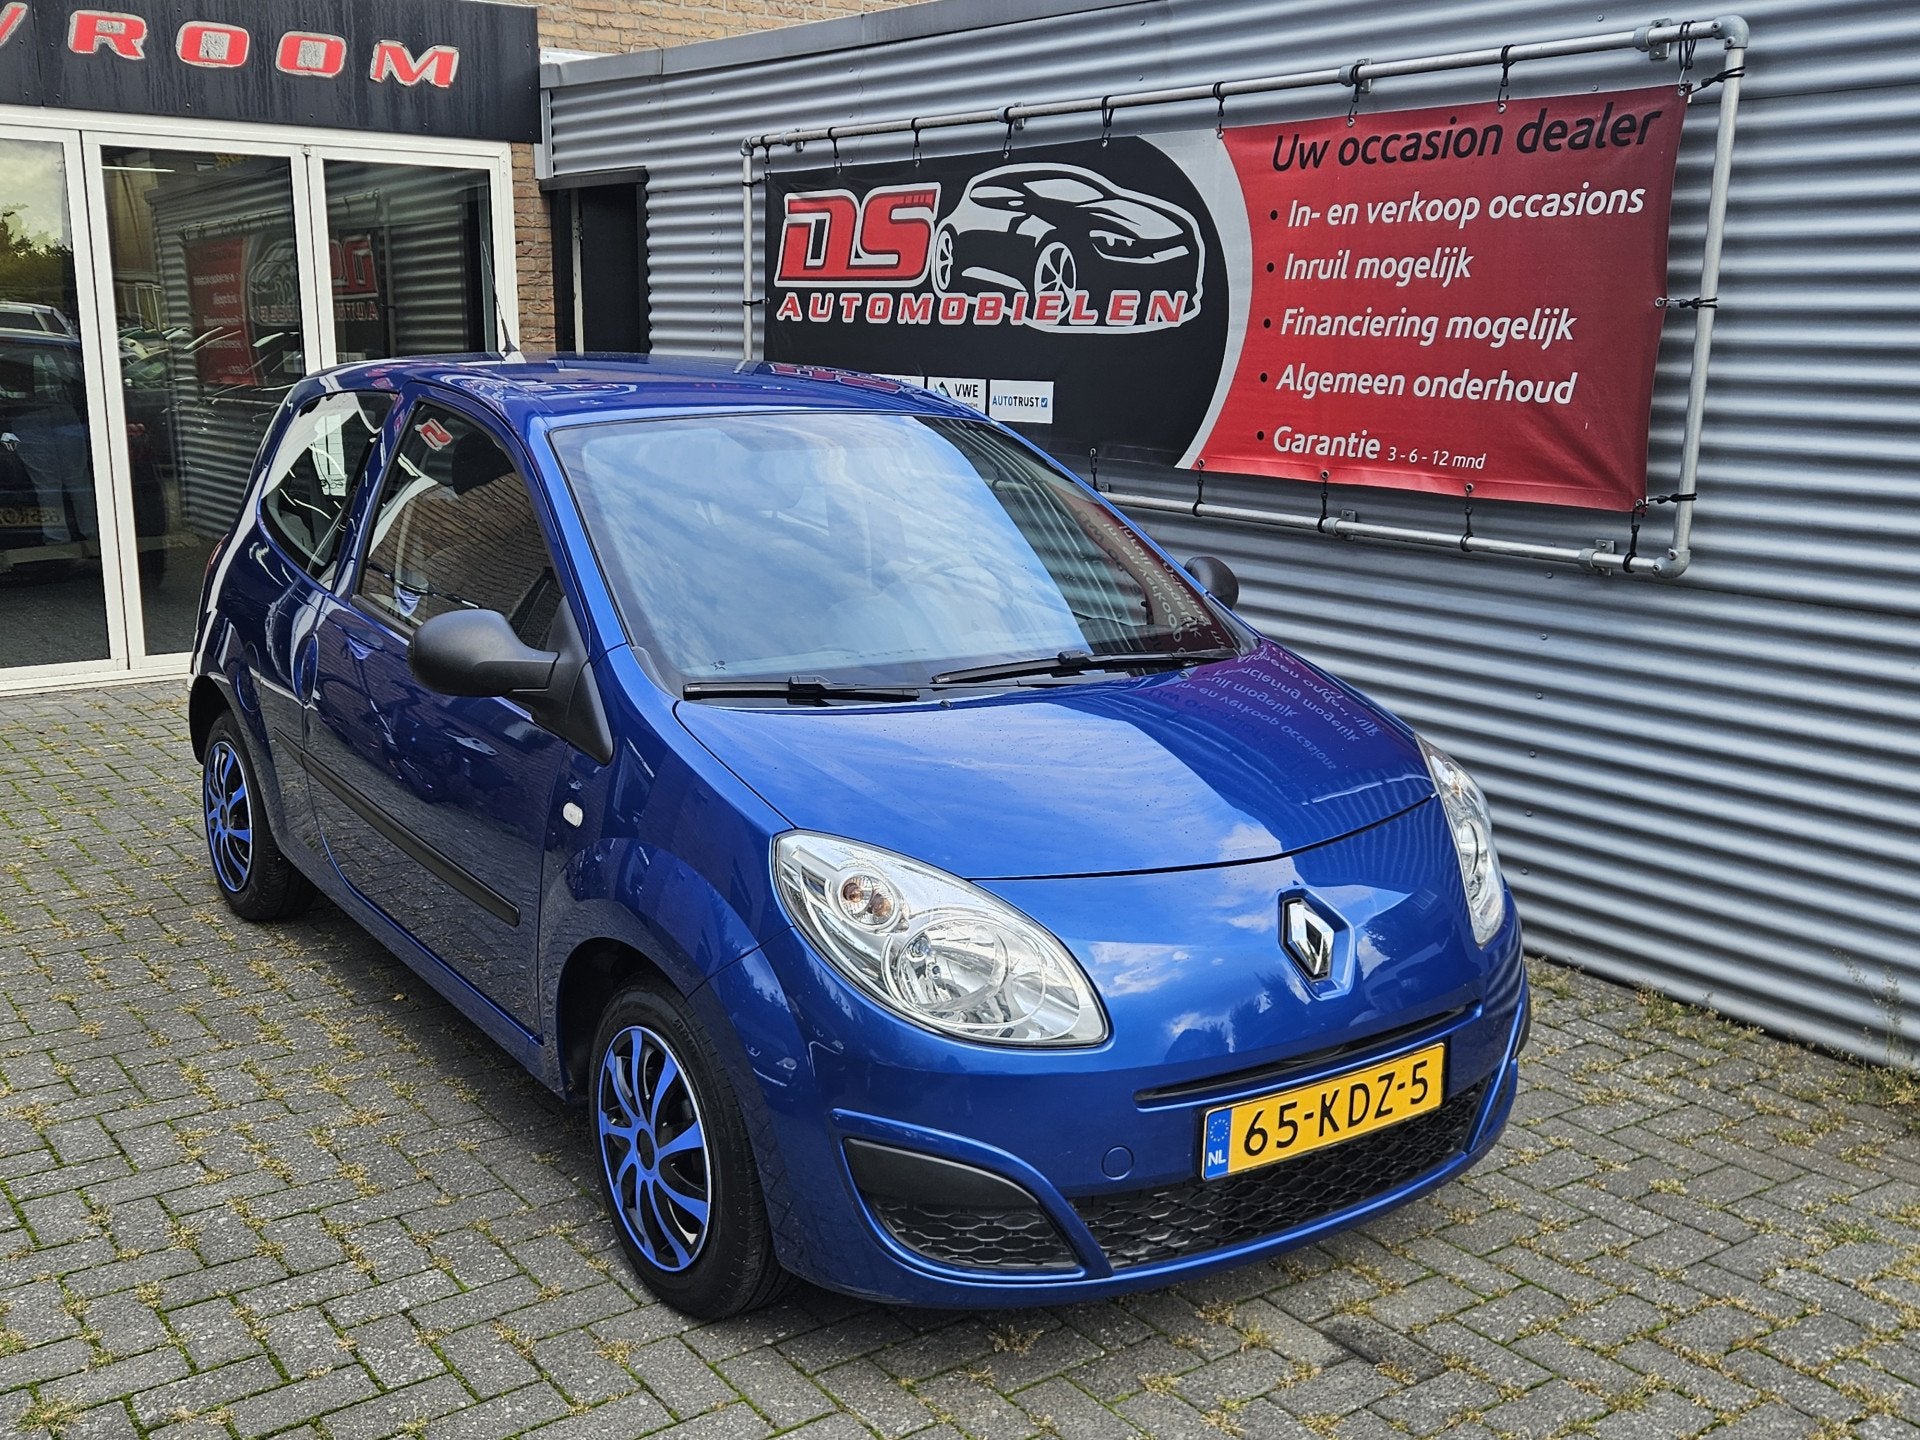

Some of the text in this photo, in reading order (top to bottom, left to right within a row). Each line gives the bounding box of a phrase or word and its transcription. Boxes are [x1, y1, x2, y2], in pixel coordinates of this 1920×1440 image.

[1272, 102, 1662, 172] Uw occasion dealer
[1287, 182, 1646, 229] In- en verkoop occasions
[775, 183, 941, 287] DS
[1284, 247, 1474, 288] Inruil mogelijk
[777, 290, 1187, 325] AUTOMOBIELEN
[1280, 307, 1577, 350] Financiering mogelijk
[954, 383, 979, 398] VWE
[992, 396, 1039, 408] AUTOTRUST
[1276, 364, 1578, 404] Algemeen onderhoud
[1273, 426, 1382, 460] Garantie
[1452, 453, 1487, 469] mnd
[1244, 1060, 1429, 1156] 65-KDZ-5
[1207, 1150, 1227, 1167] NL
